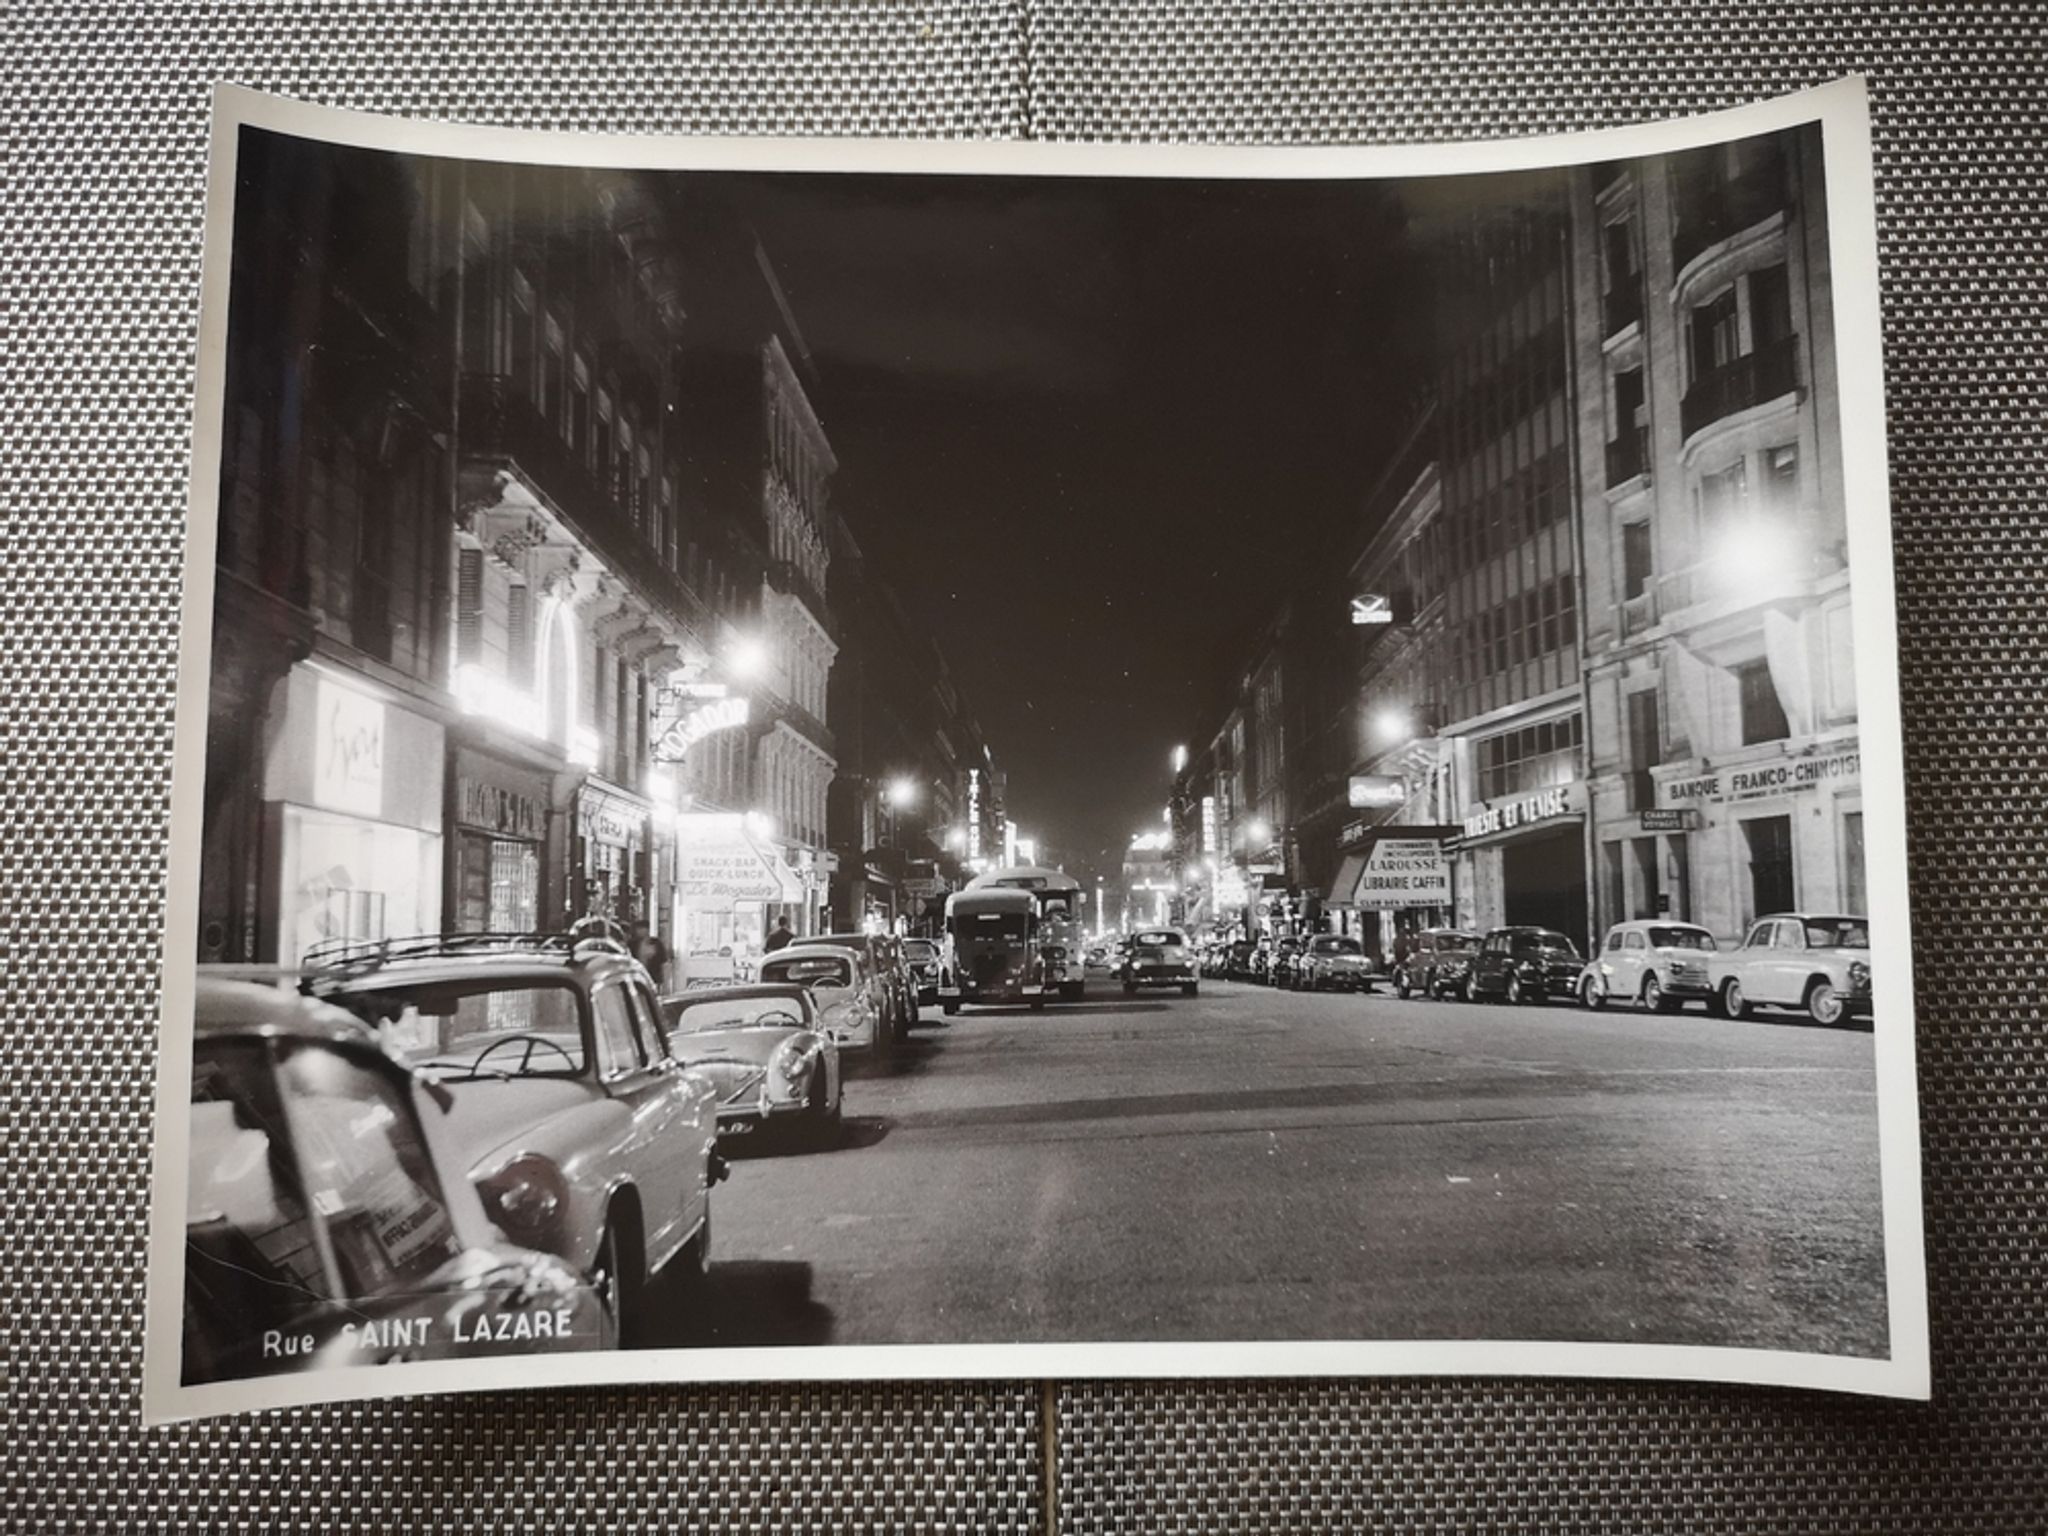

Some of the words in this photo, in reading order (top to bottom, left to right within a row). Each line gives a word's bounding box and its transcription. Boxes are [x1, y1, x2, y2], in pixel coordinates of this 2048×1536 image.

[1669, 778, 1719, 800] BANQUE
[1505, 803, 1518, 827] ET
[1521, 788, 1565, 822] VENISE
[1643, 811, 1678, 820] CHANGE
[1370, 859, 1438, 871] LAROUSSE
[1363, 876, 1409, 890] LIBRAIRIE
[1413, 876, 1445, 888] CAFFIN
